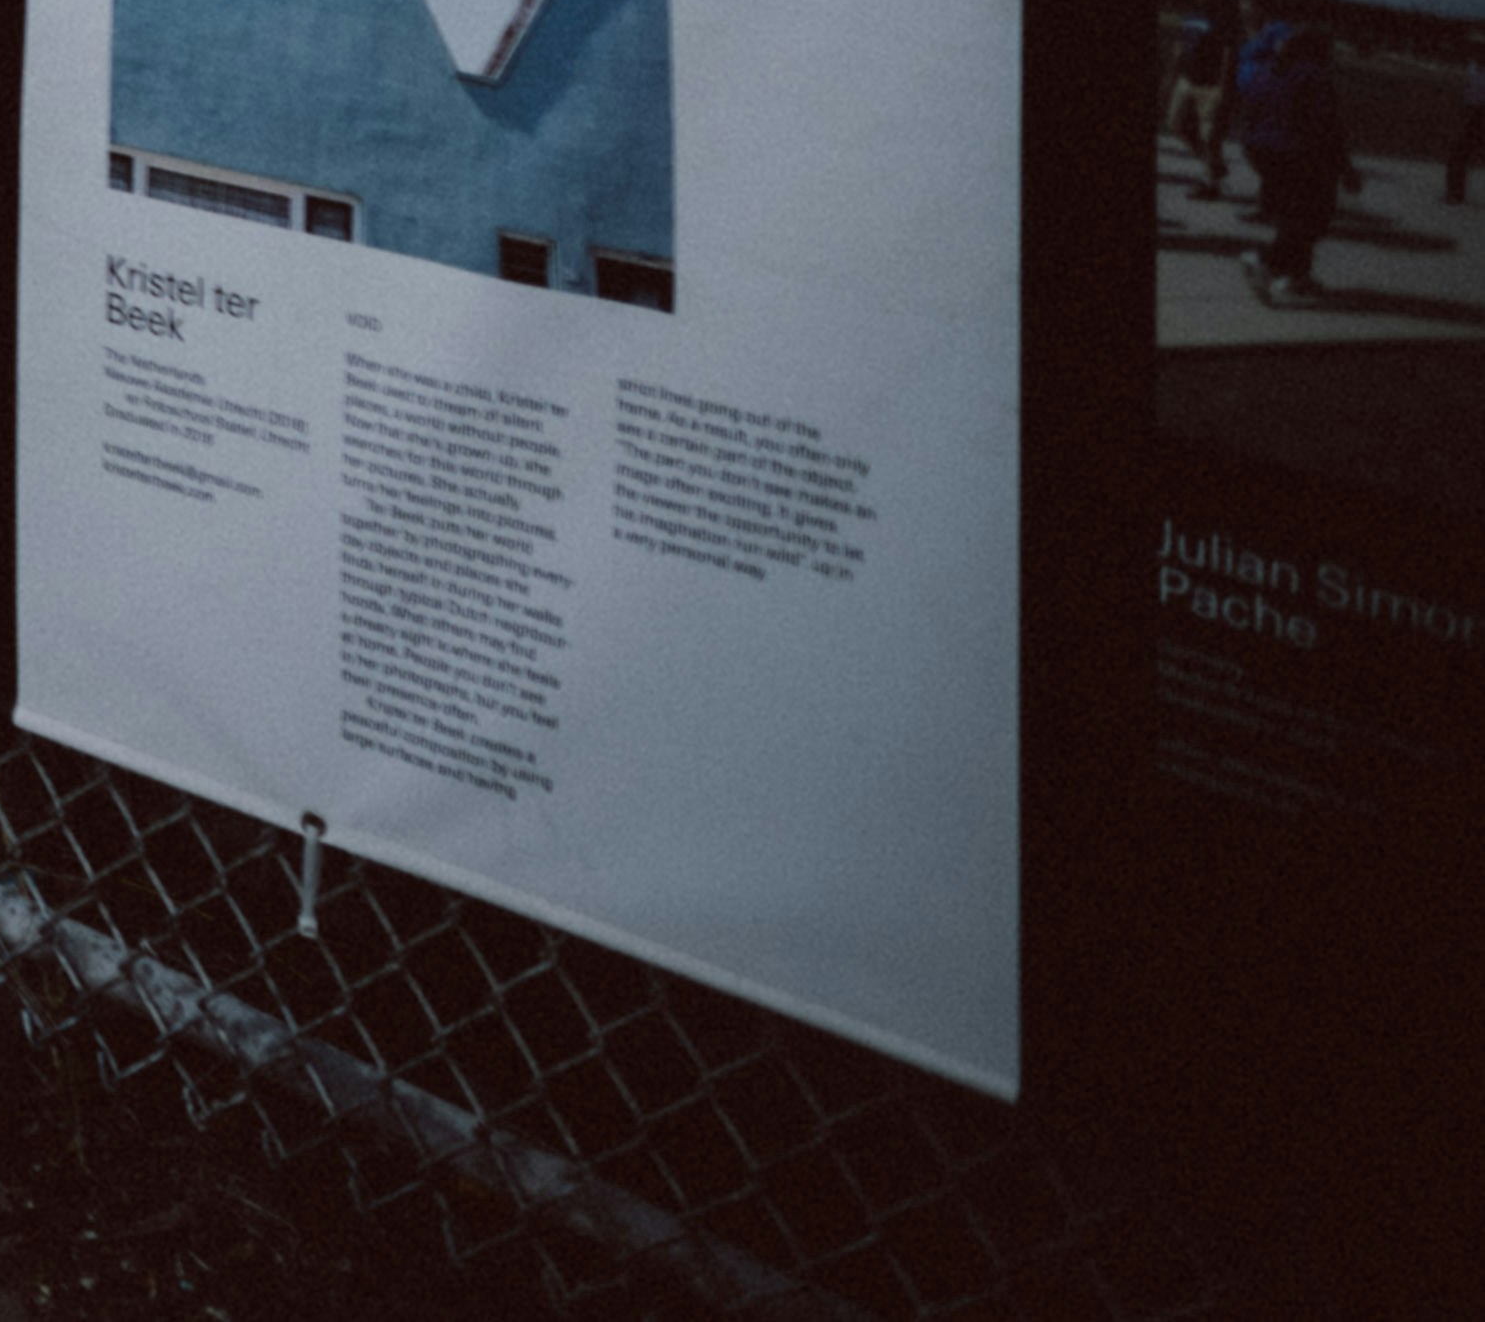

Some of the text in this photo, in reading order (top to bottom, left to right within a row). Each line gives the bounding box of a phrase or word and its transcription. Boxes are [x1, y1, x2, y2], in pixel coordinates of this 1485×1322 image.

[105, 292, 185, 342] Beek
[106, 254, 260, 320] Kristel ter
[1157, 517, 1300, 595] Julian
[1158, 566, 1318, 650] Pache
